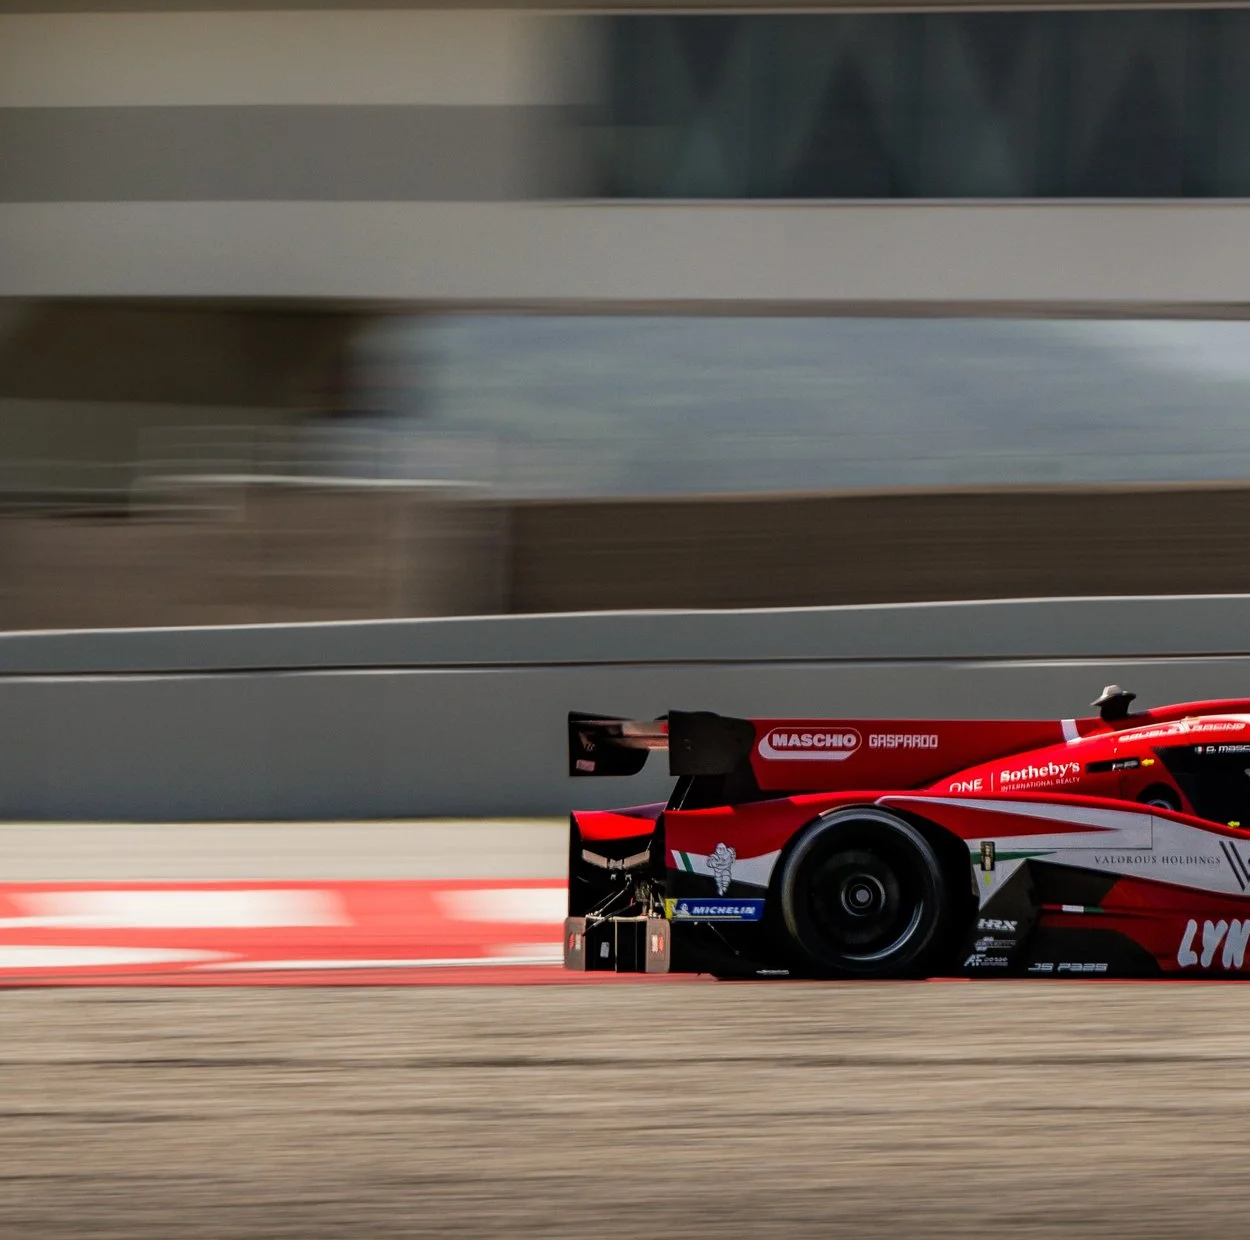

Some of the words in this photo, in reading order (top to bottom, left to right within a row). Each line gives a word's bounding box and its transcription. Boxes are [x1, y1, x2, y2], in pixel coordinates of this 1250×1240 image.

[772, 733, 857, 748] MASCHIO
[868, 734, 939, 749] GASPARDO
[949, 778, 983, 792] ONE
[1000, 762, 1081, 784] Sotheby's
[1001, 779, 1055, 792] INTERNATIONAL
[1056, 776, 1081, 785] REALTY
[1094, 855, 1157, 865] VALOROUS
[1161, 855, 1221, 865] HOLDINGS
[692, 906, 756, 915] MICHELIN
[977, 918, 1018, 931] HRX
[1027, 962, 1054, 971] JS
